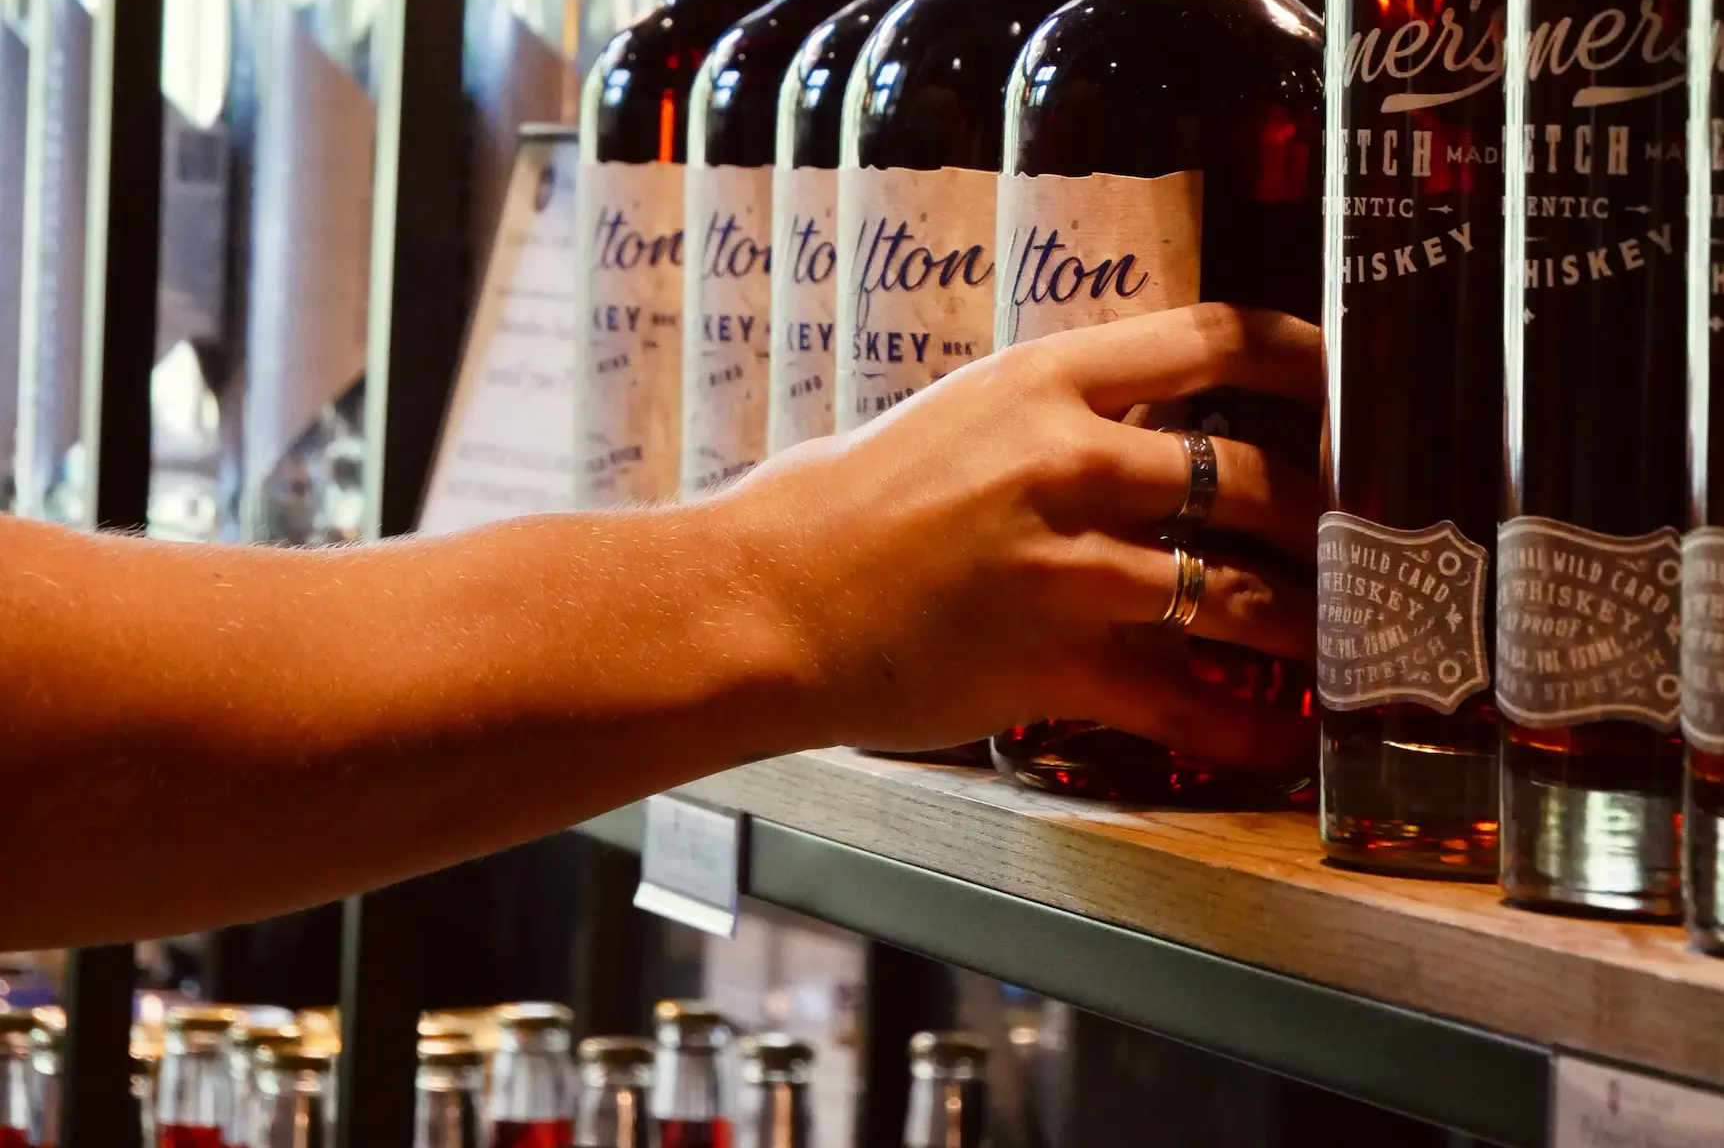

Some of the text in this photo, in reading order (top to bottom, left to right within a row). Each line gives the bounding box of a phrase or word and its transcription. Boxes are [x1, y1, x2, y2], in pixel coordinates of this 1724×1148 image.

[1321, 571, 1426, 622] WHISKEY
[1351, 543, 1391, 575] WILD
[1398, 561, 1450, 604] CARD
[1553, 550, 1604, 585] WILD
[1611, 568, 1671, 615] CARD
[1327, 603, 1376, 627] PROOF
[1512, 578, 1642, 635] WHISKEY
[1522, 612, 1583, 640] PROOF
[1344, 634, 1447, 689] STRETCH
